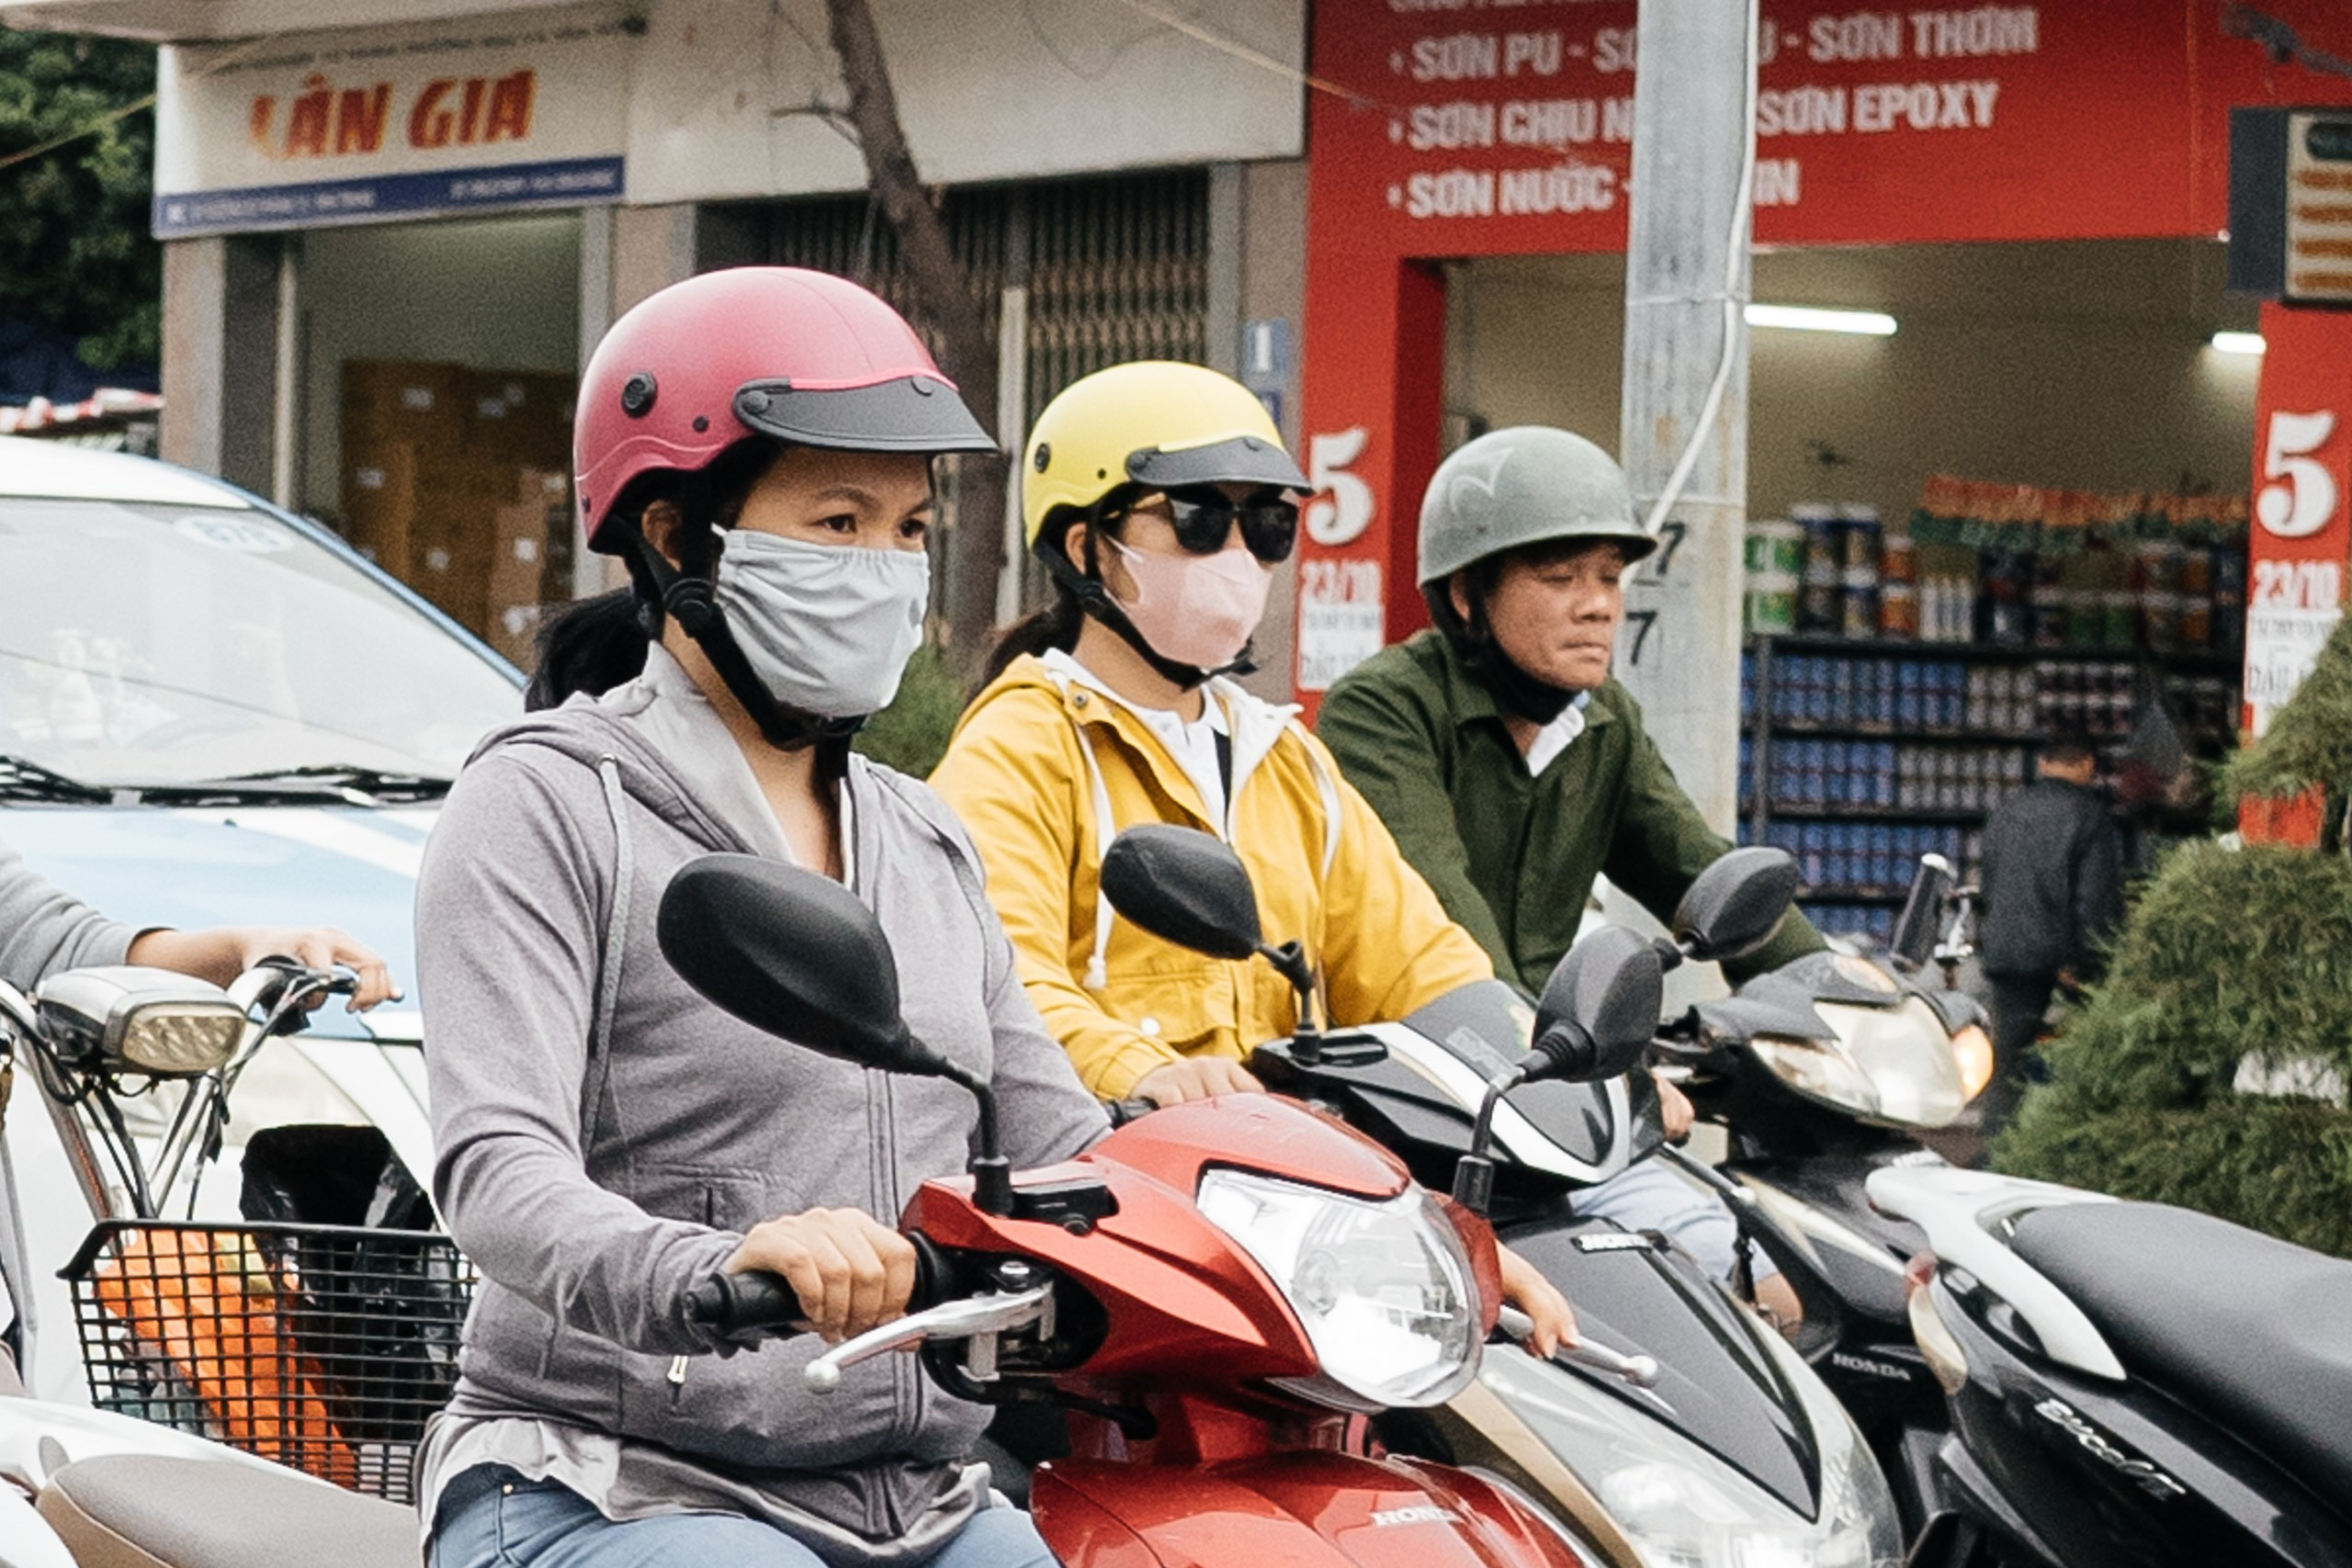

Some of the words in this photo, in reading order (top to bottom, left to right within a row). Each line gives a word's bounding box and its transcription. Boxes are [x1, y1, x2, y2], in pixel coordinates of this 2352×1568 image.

[1504, 32, 1561, 76] PU
[407, 68, 538, 151] GIA
[1853, 81, 2000, 133] EPOXY
[1306, 426, 1374, 546] 5
[2256, 411, 2338, 538] 5
[1657, 521, 1687, 576] 7
[1625, 610, 1658, 666] 7
[1833, 1353, 1912, 1382] HONDA
